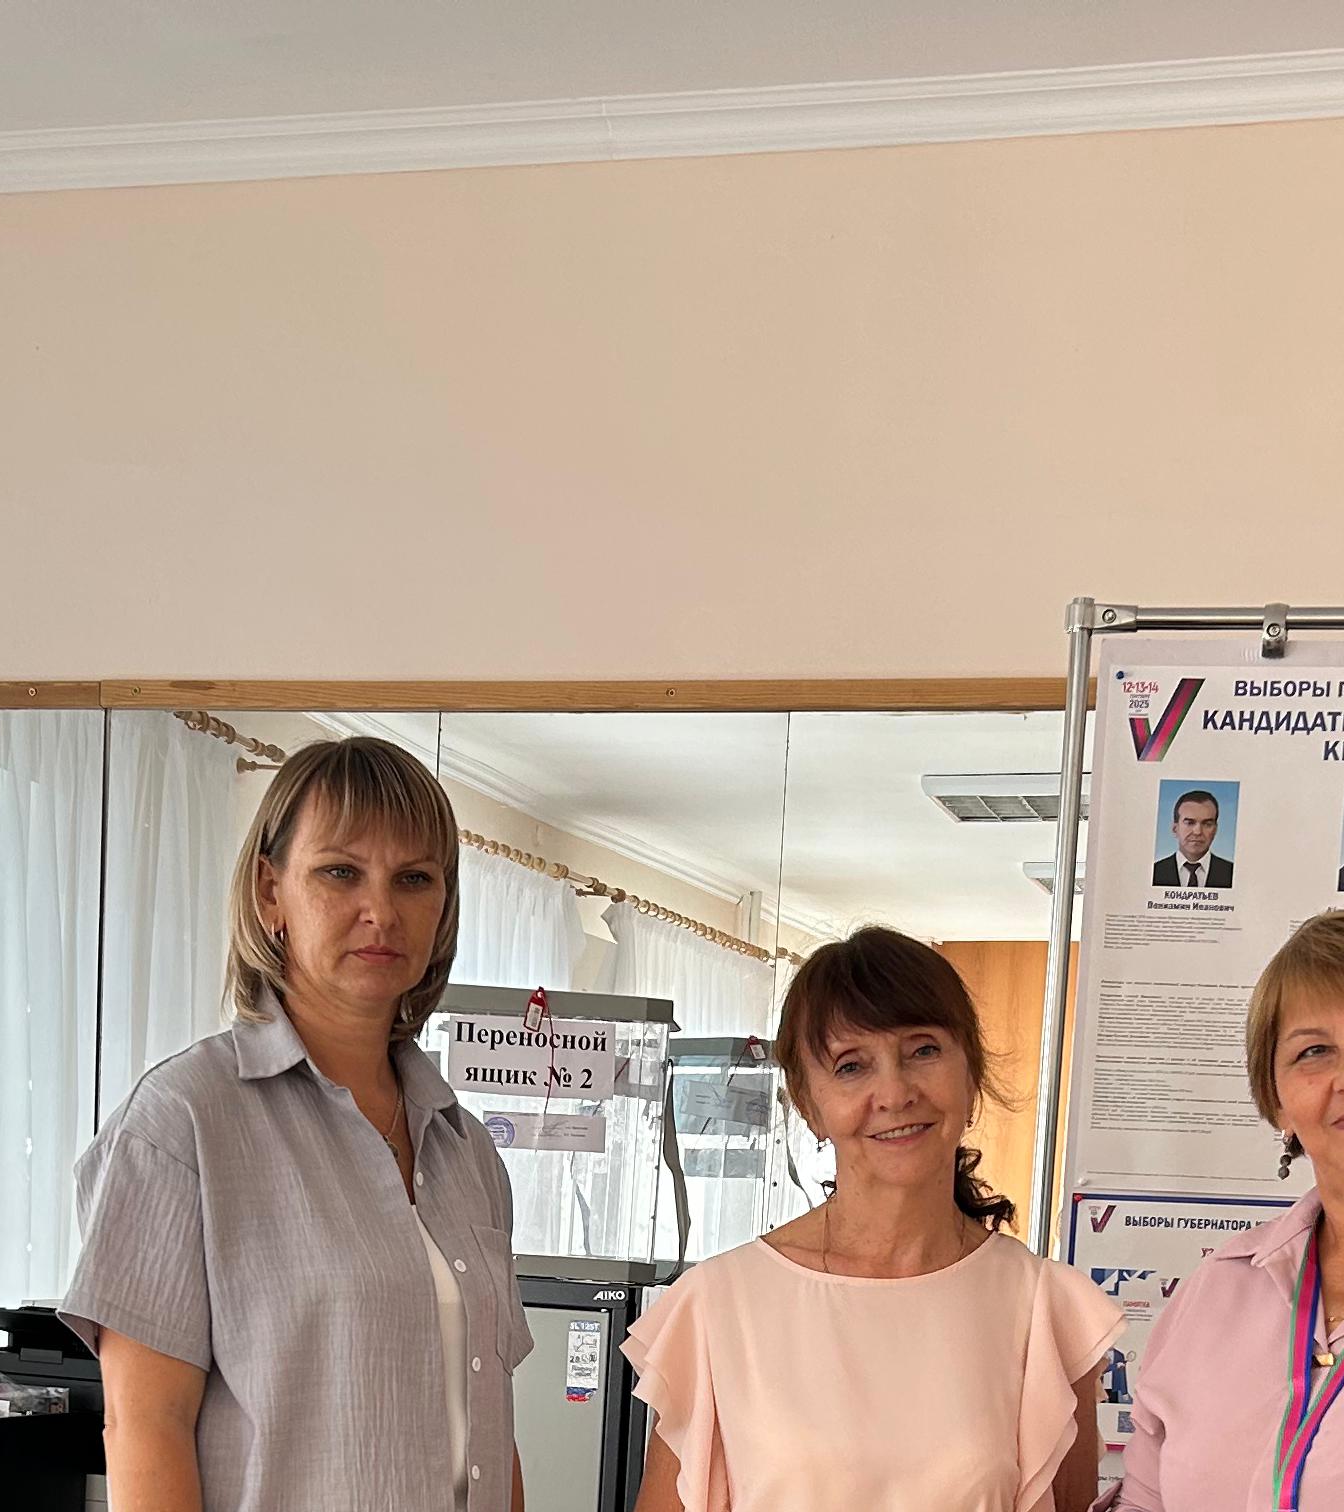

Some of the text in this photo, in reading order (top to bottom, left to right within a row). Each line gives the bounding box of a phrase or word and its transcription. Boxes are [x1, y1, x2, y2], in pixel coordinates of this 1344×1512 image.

[1234, 680, 1330, 698] ВЫБОРЫ
[455, 1021, 607, 1051] Переносной
[465, 1064, 593, 1088] ящик № 2
[1125, 1216, 1252, 1231] ВЫБОРЫ ГУБЕРНАТОРА
[593, 1291, 626, 1300] AIKO
